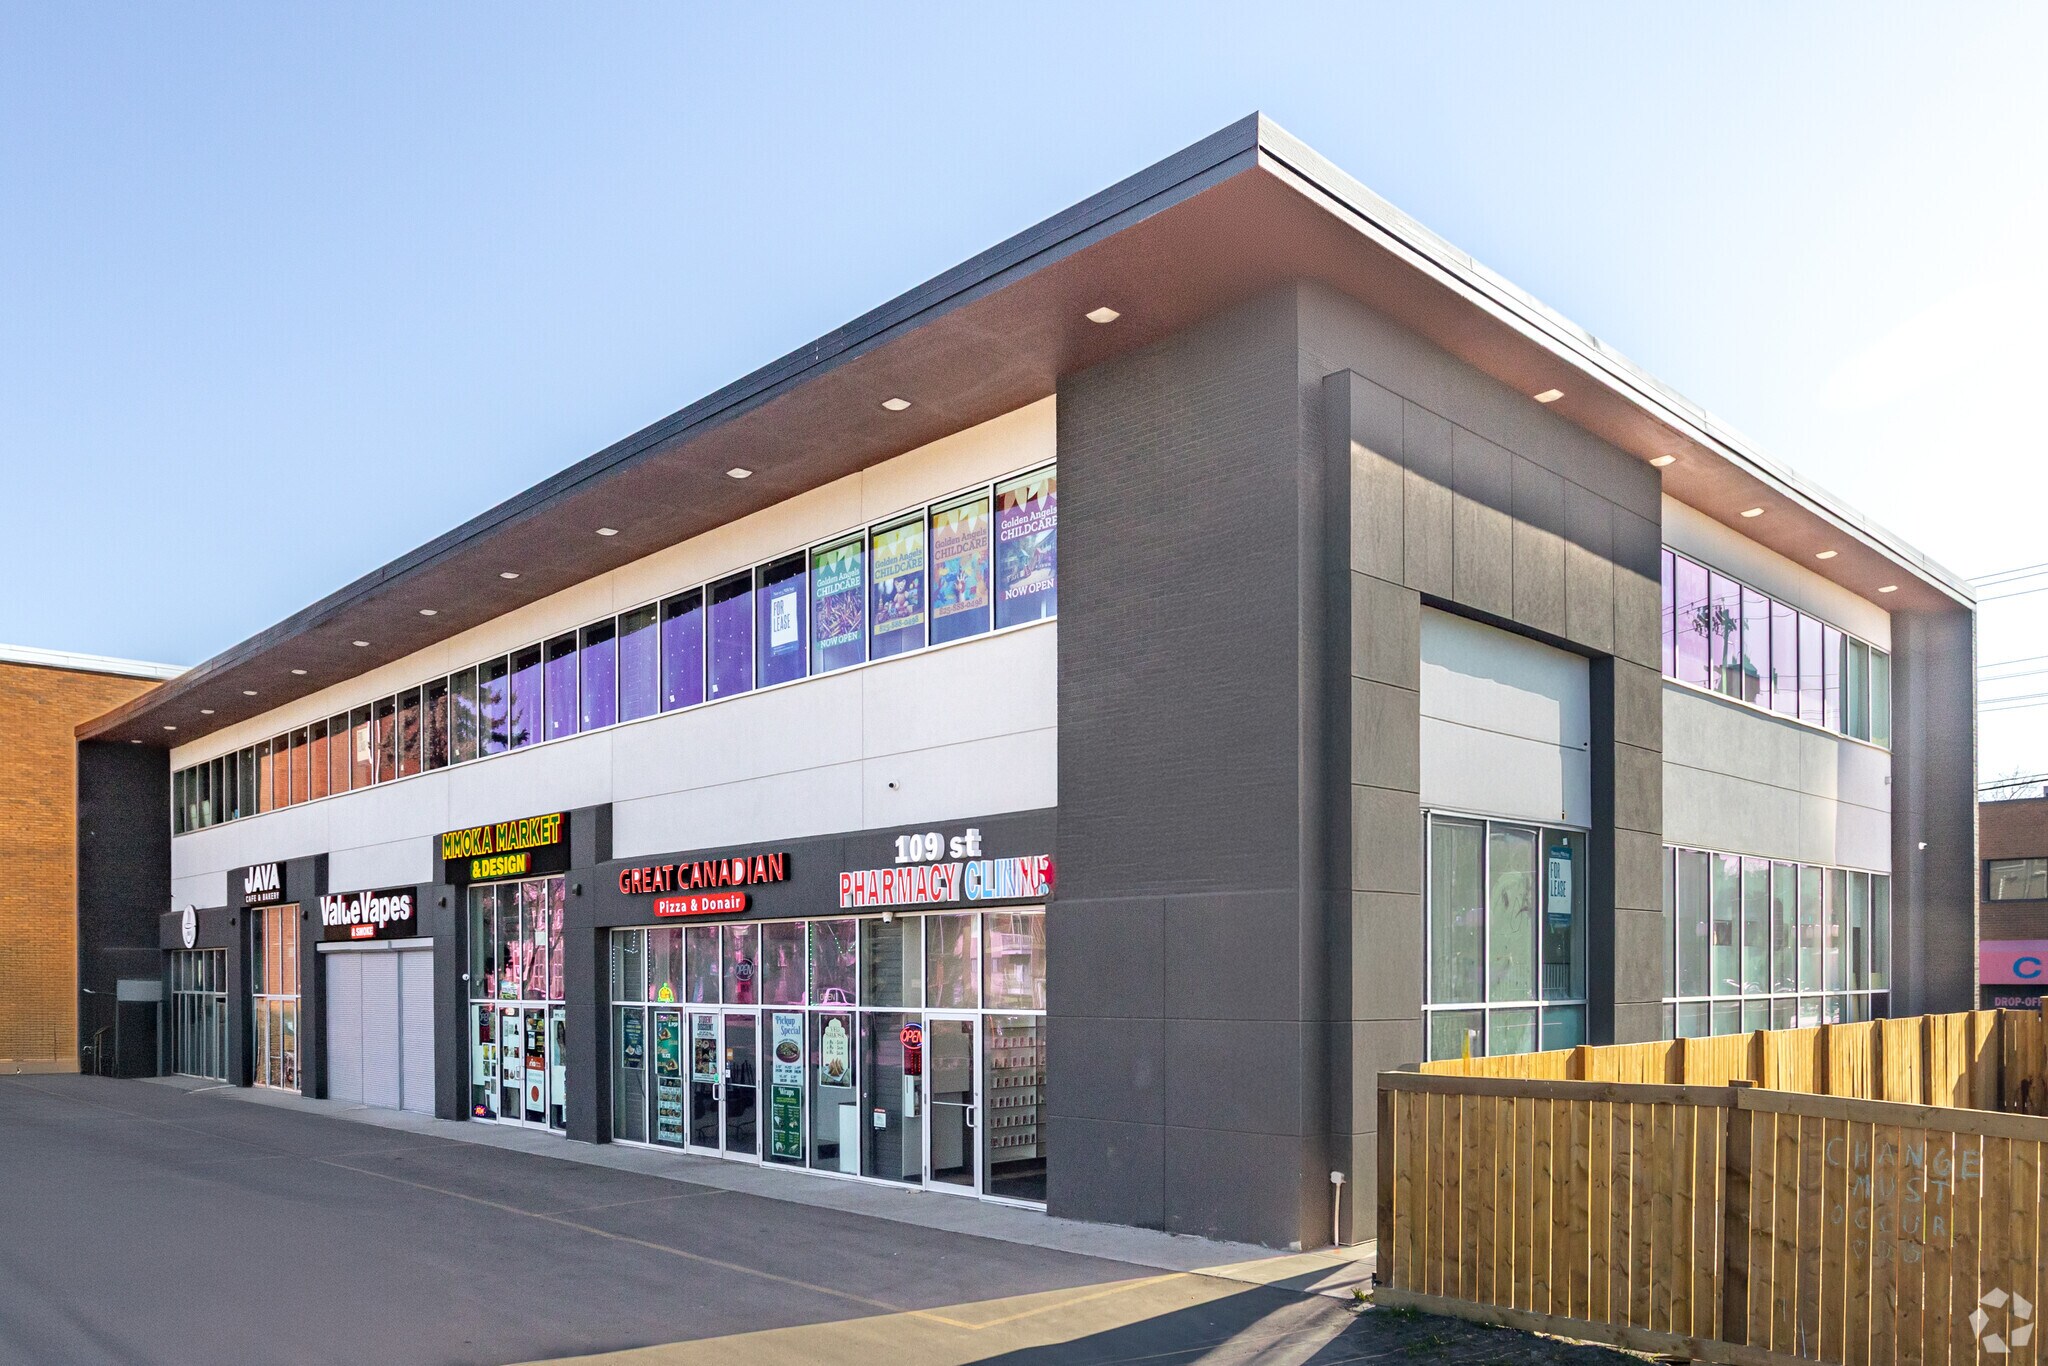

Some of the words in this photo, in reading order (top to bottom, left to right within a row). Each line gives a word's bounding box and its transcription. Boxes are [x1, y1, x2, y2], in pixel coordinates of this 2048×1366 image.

[1000, 515, 1057, 541] CHILDCARE
[1001, 514, 1029, 530] Golden
[1030, 506, 1057, 521] Angels
[934, 537, 987, 560] CHILDCARE
[935, 536, 960, 549] Golden
[961, 528, 987, 543] Angels
[875, 557, 898, 569] Golden
[899, 547, 922, 561] Angels
[875, 557, 922, 579] CHILDCARE
[816, 575, 838, 587] Golden
[839, 569, 860, 583] Angels
[816, 577, 861, 597] CHILDCARE
[1005, 585, 1028, 600] NOW
[1029, 578, 1055, 594] OPEN
[773, 599, 784, 616] FOR
[773, 613, 790, 633] LEASE
[820, 637, 837, 649] NOW
[839, 631, 858, 645] OPEN
[442, 826, 493, 860] MMOKA
[496, 813, 560, 852] MARKET
[895, 832, 943, 863] 109
[950, 828, 982, 859] st
[472, 861, 481, 879] &
[482, 853, 526, 877] DESIGN
[619, 865, 674, 894] GREAT
[677, 852, 784, 890] CANADIAN
[1550, 861, 1560, 879] FOR
[244, 863, 280, 894] JAVA
[840, 862, 961, 908] PHARMACY
[1550, 880, 1566, 898] LEASE
[320, 891, 411, 928] ValueVapes
[659, 901, 687, 914] Pizza
[690, 899, 698, 912] &
[702, 895, 741, 911] Donair
[355, 926, 374, 937] SMOKE
[2012, 956, 2042, 979] C
[775, 1015, 795, 1027] Pickup
[780, 1026, 801, 1036] Special
[901, 1030, 922, 1044] OPEN
[1827, 1138, 1980, 1180] CHANGE
[1852, 1175, 1950, 1204] MUST
[1831, 1204, 1946, 1236] OCCUR
